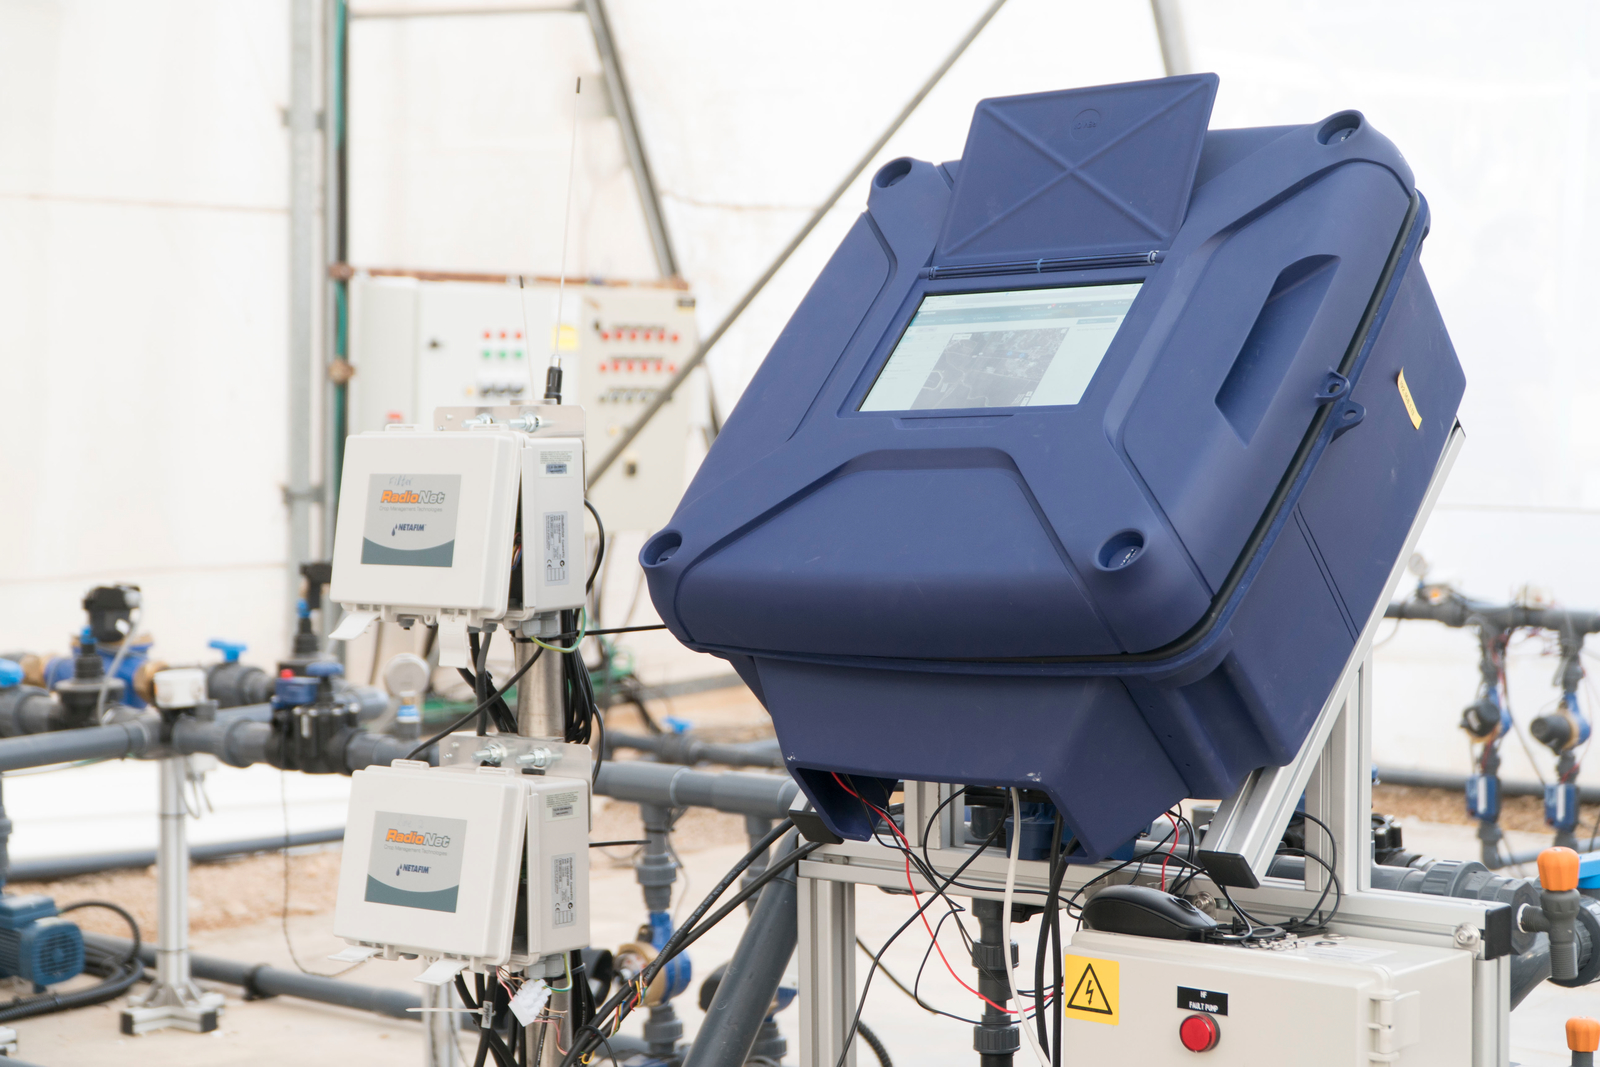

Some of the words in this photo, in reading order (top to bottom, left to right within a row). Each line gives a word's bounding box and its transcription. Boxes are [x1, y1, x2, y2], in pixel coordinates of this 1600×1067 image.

[381, 490, 445, 504] RadioNet
[398, 523, 425, 531] NETAFIM
[385, 828, 451, 848] RadioNet
[394, 845, 421, 853] Management
[422, 848, 447, 856] Technologies
[402, 864, 429, 874] NETAFIM
[1188, 1001, 1204, 1011] FAULT
[1205, 1003, 1219, 1013] PUMP
